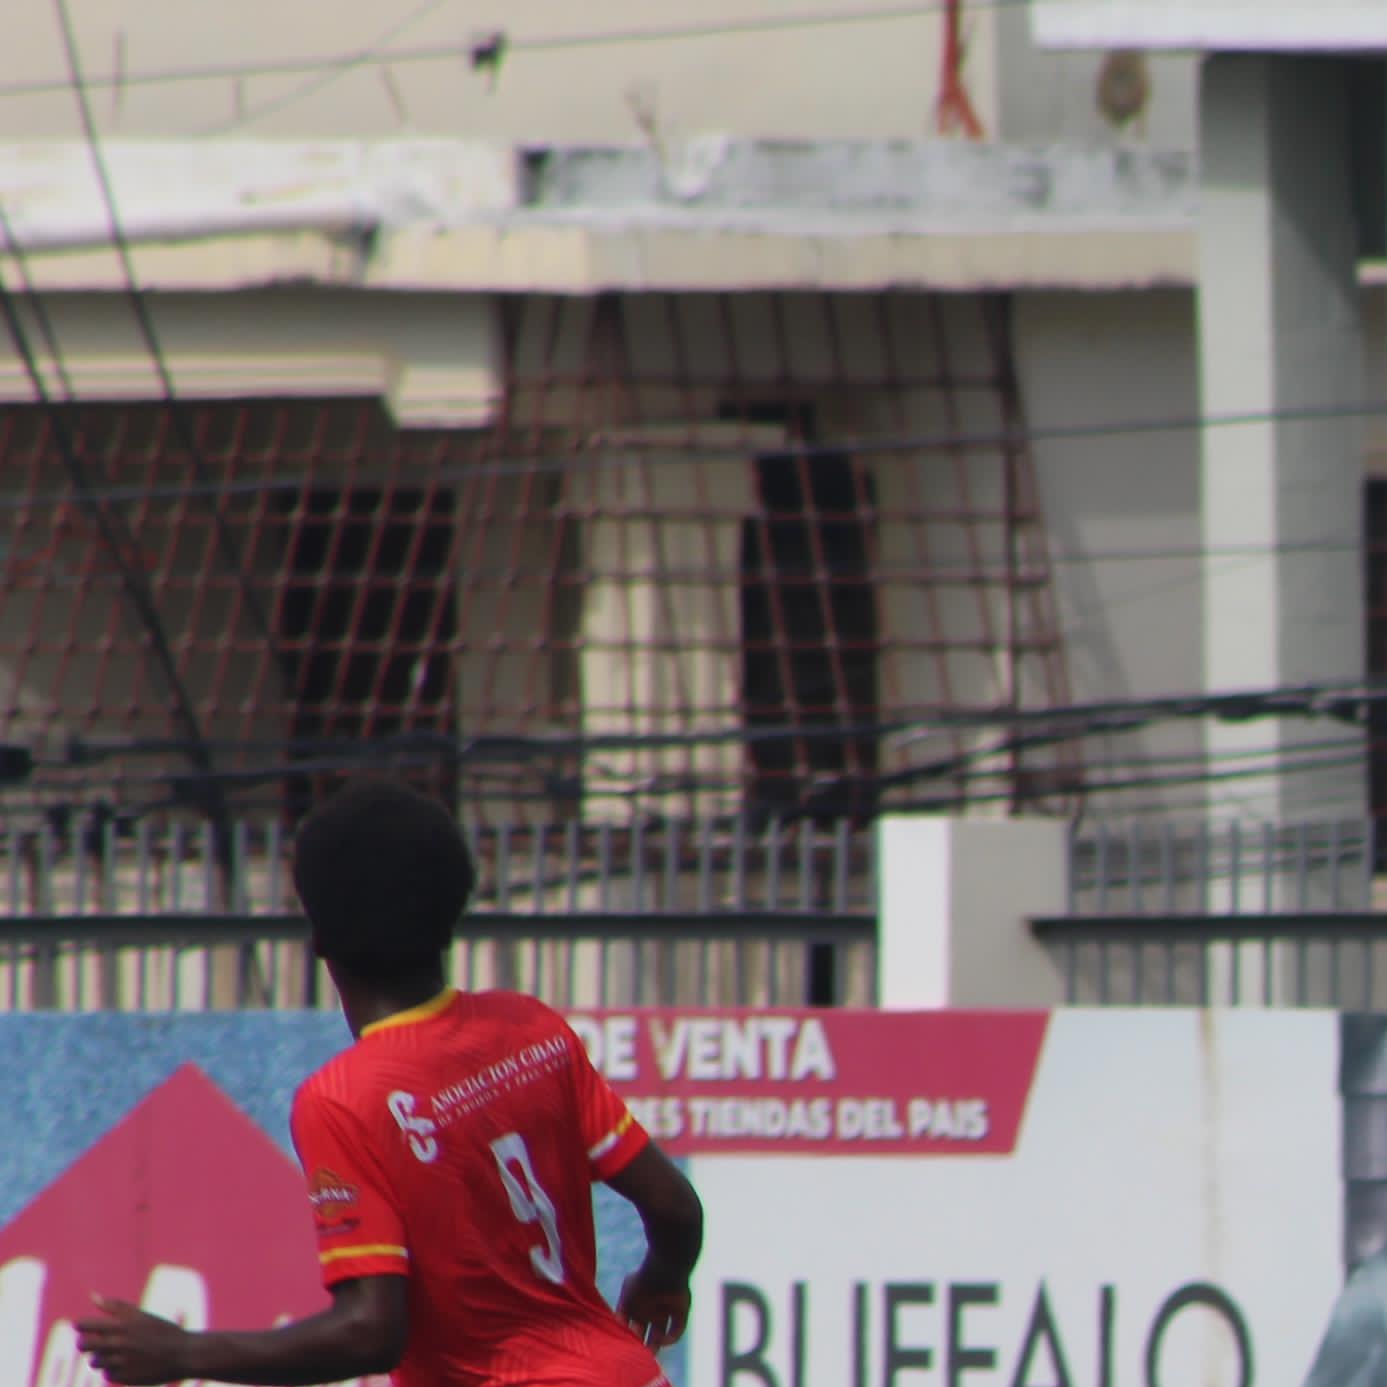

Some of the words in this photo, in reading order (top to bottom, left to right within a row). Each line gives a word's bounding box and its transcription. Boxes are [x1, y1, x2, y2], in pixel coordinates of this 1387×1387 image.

[648, 1017, 836, 1081] VENTA
[689, 1096, 832, 1140] TIENDAS
[836, 1098, 905, 1141] DEL
[907, 1097, 989, 1142] PAIS
[489, 1132, 565, 1285] 9
